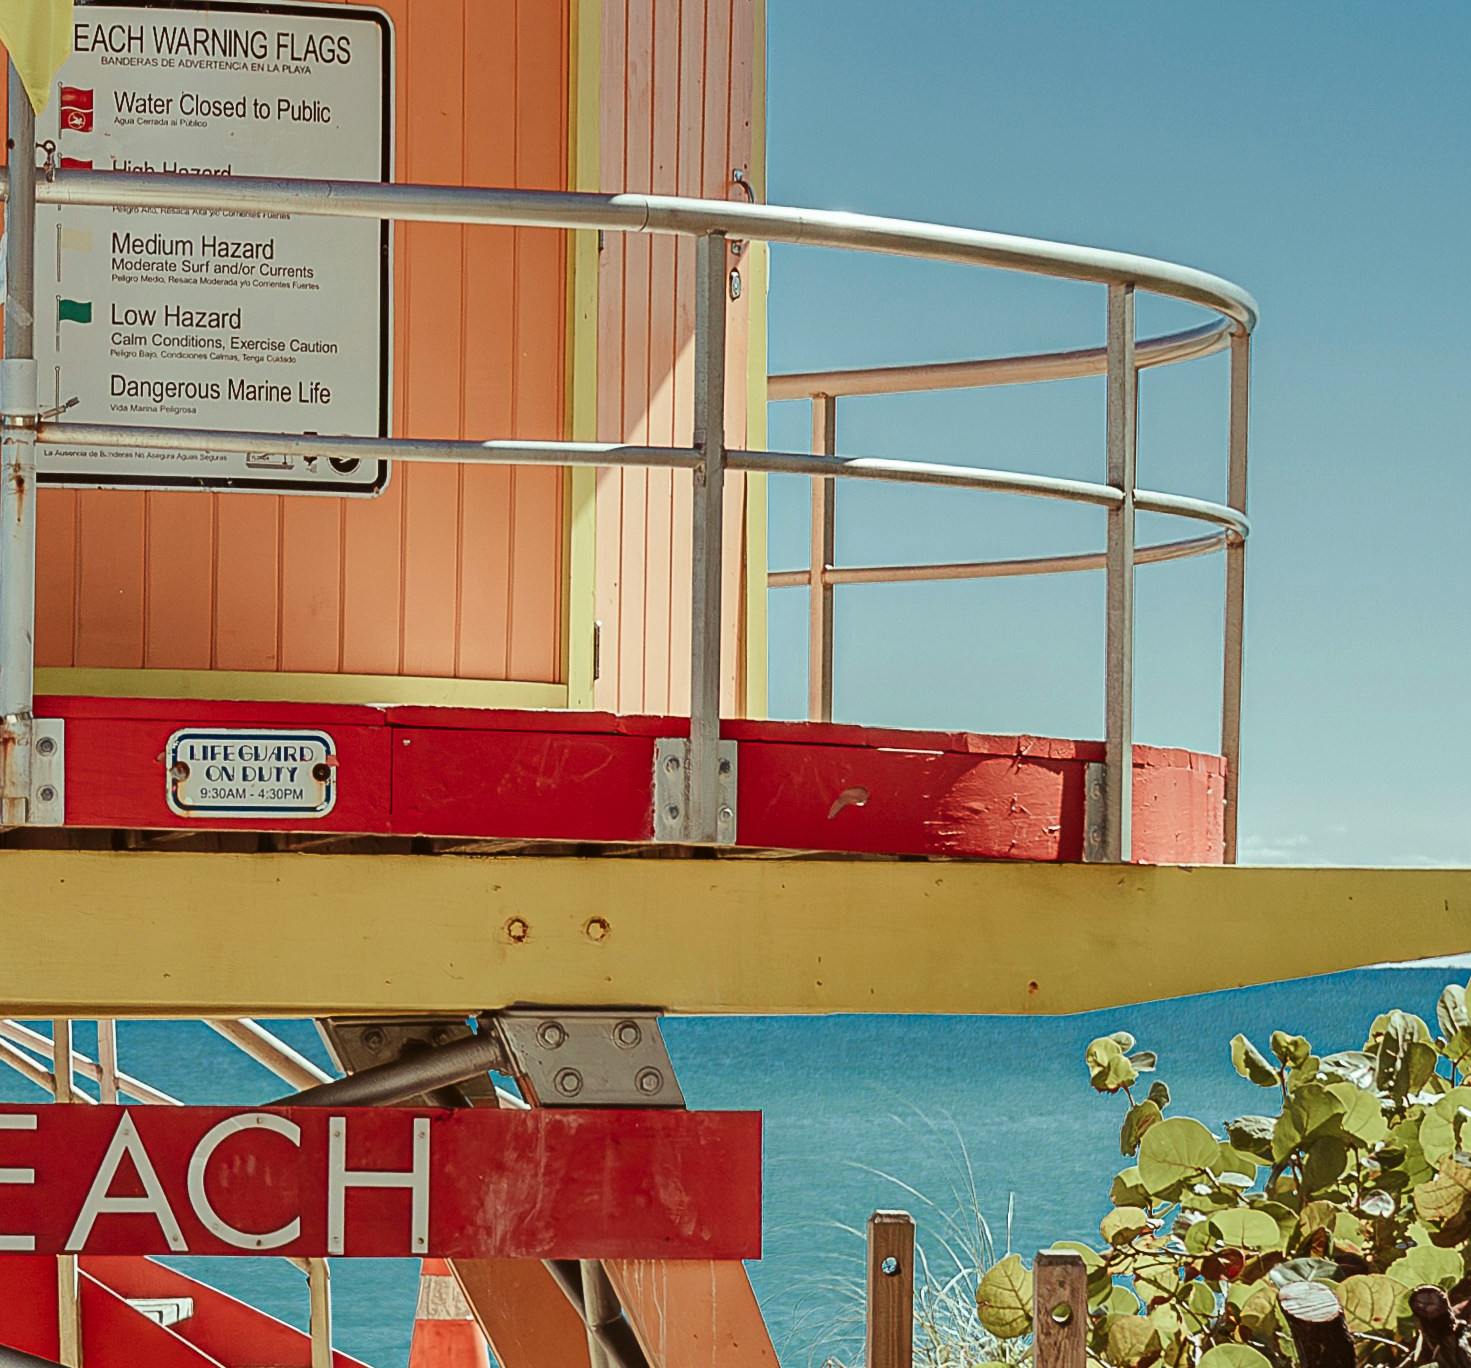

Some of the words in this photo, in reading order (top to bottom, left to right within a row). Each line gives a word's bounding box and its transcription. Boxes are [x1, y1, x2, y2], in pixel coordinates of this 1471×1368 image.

[74, 24, 144, 52] EACH
[153, 26, 268, 58] WARNING
[276, 32, 351, 64] FLAGS
[101, 57, 158, 66] BANDERAS
[161, 59, 175, 67] DE
[178, 60, 248, 71] ADVERTENCIA
[251, 63, 264, 71] EN
[267, 64, 281, 72] LA
[283, 65, 311, 74] PLAYA
[114, 91, 173, 114] Water
[180, 94, 246, 118] Closed
[254, 98, 270, 118] to
[278, 99, 331, 123] Public
[114, 117, 134, 125] Agua
[137, 118, 168, 126] Cerrada
[112, 232, 193, 256] Medium
[202, 236, 274, 260] Hazard
[112, 258, 177, 272] Moderate
[182, 260, 210, 273] Surf
[214, 262, 255, 276] and/or
[260, 263, 314, 278] Currents
[112, 274, 138, 283] Peligro
[169, 276, 197, 284] Resaca
[200, 277, 237, 286] Moderada
[240, 280, 250, 288] y/o
[253, 280, 290, 288] Corrientes
[293, 281, 319, 290] Fuertes
[112, 304, 156, 326] Low
[164, 305, 241, 329] Hazard
[112, 333, 147, 346] Calm
[152, 334, 226, 350] Conditions,
[230, 337, 285, 352] Exercise
[290, 340, 338, 354] Caution
[110, 349, 136, 359] Peligro
[243, 354, 264, 363] Tenga
[267, 355, 296, 363] Cuidado
[111, 375, 220, 402] Dangerous
[228, 378, 292, 402] Marine
[298, 382, 331, 404] Life
[160, 405, 196, 414] Peligrosa
[200, 454, 227, 462] Seguras
[189, 745, 314, 762] LIFEGUARD
[206, 765, 235, 782] ON
[242, 766, 298, 782] DUTY
[200, 788, 246, 799] 9:30AM
[258, 789, 303, 799] 4:30PM
